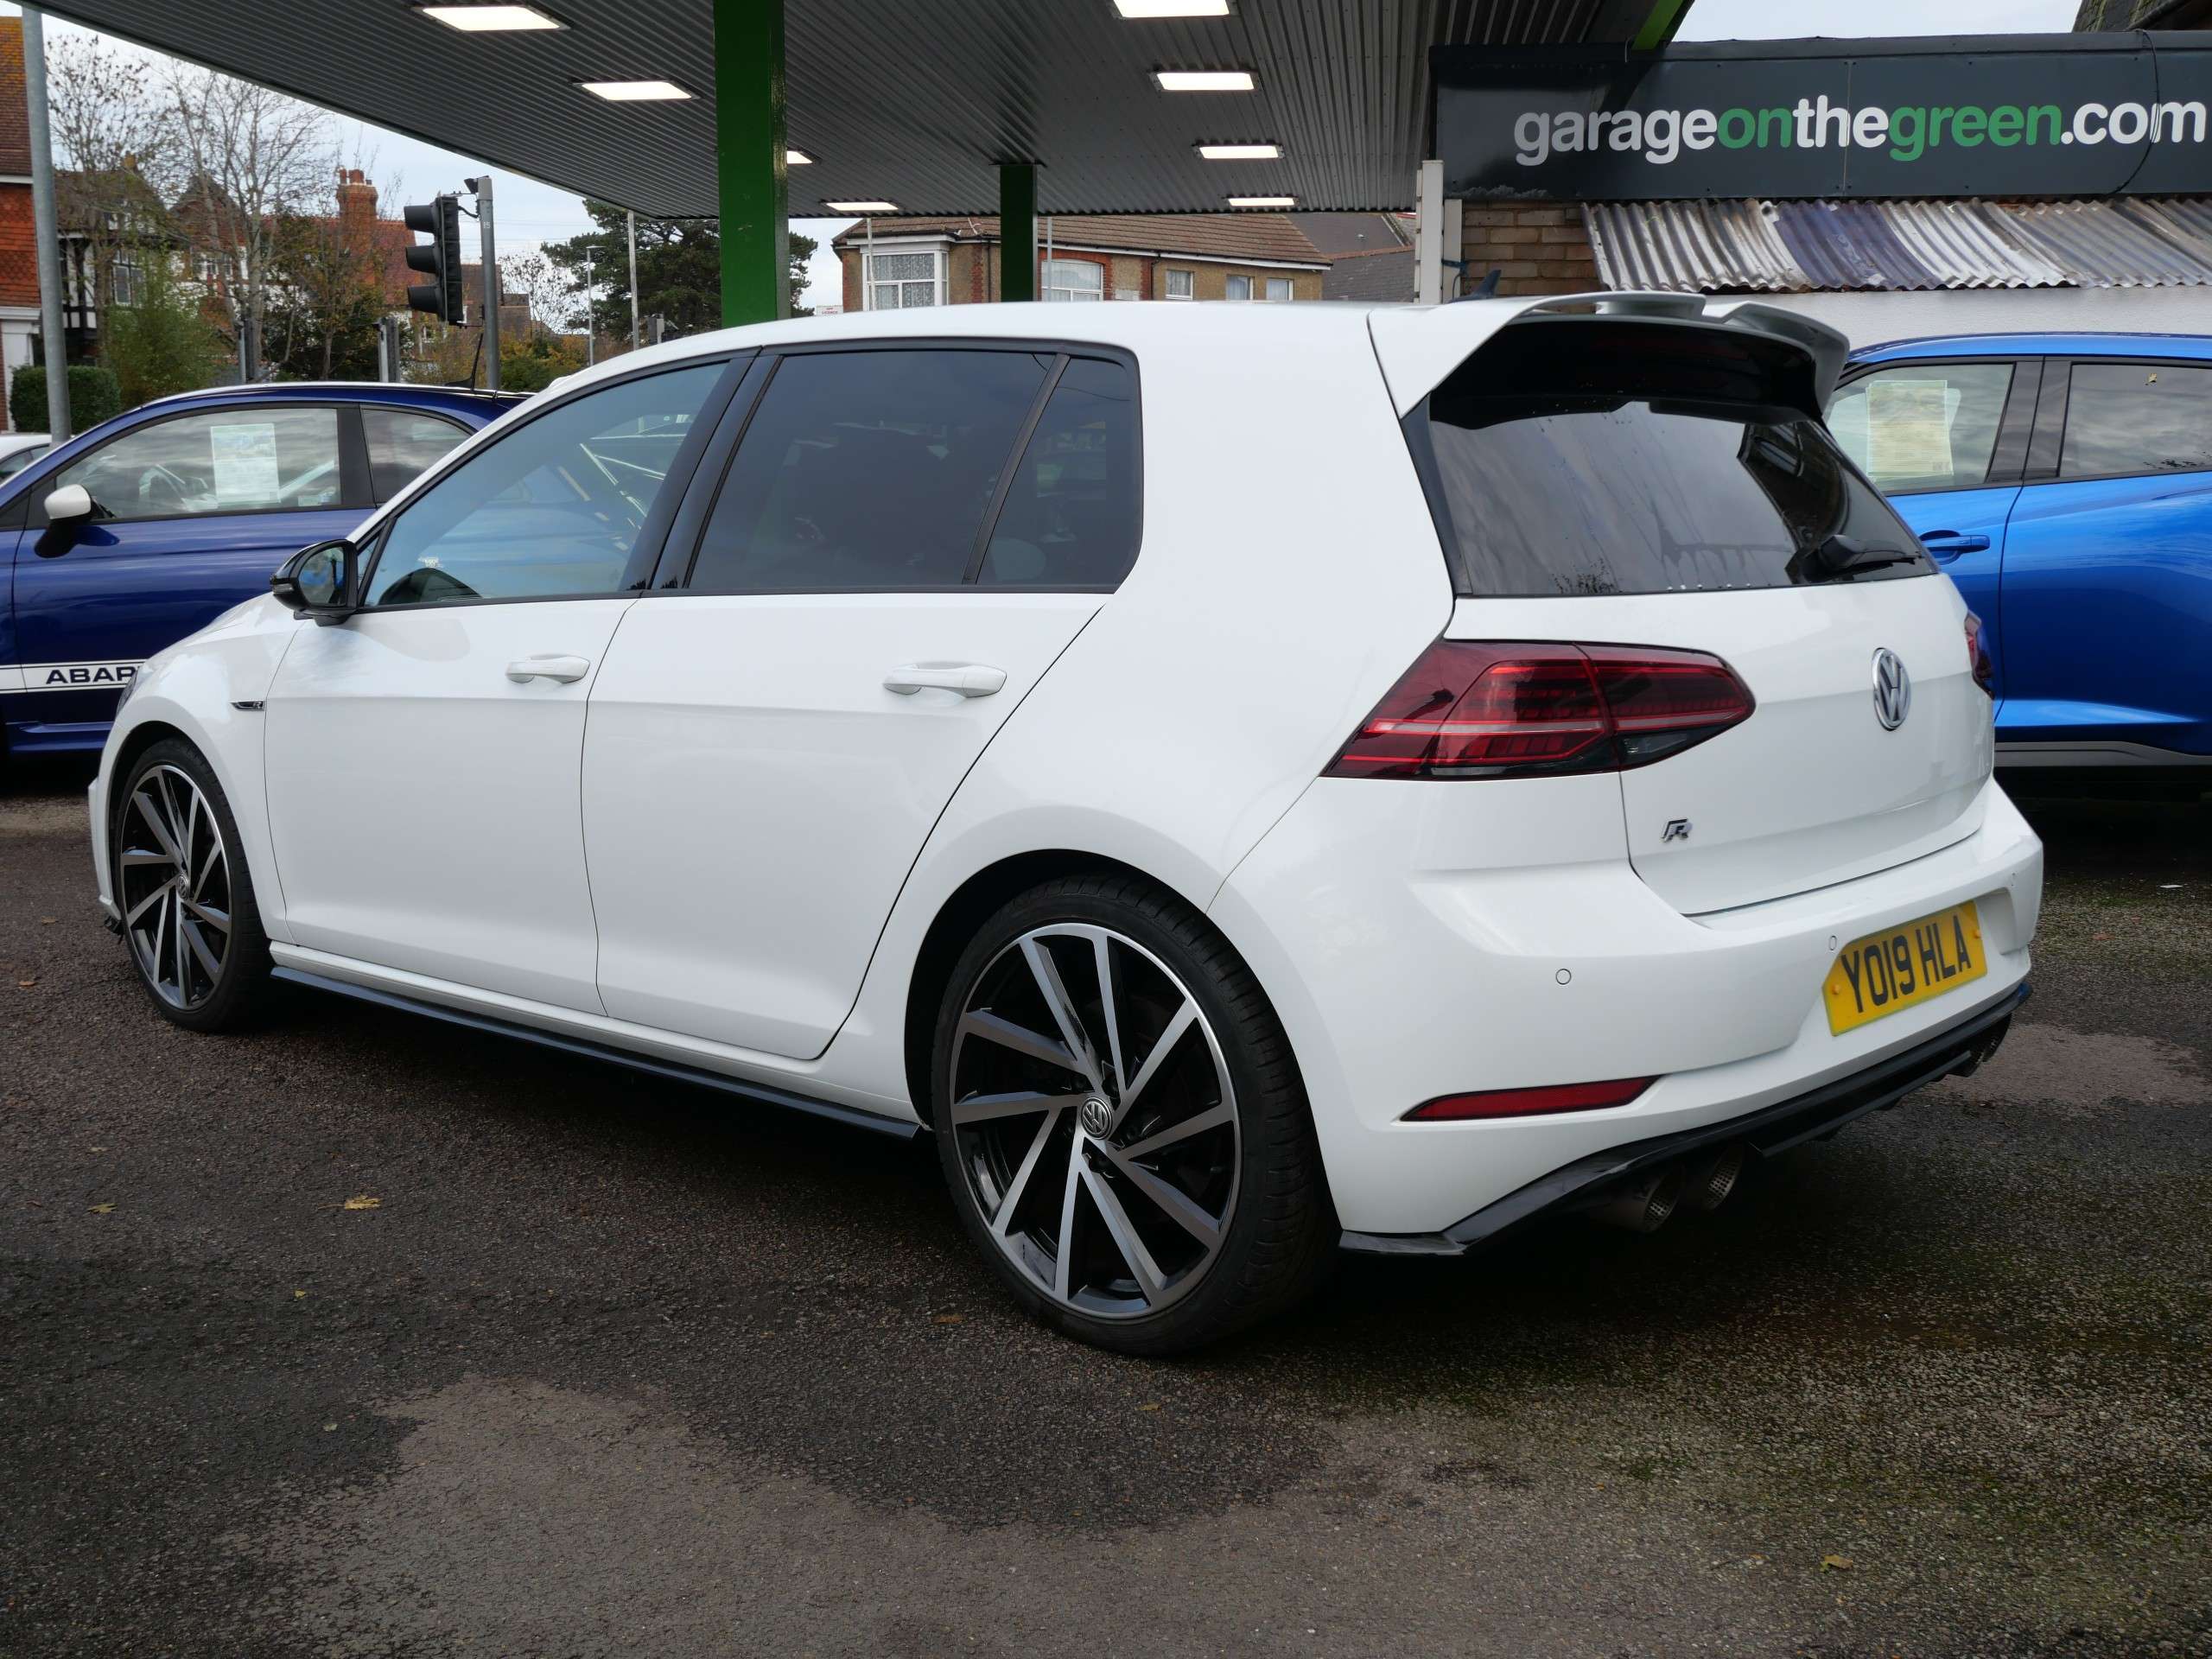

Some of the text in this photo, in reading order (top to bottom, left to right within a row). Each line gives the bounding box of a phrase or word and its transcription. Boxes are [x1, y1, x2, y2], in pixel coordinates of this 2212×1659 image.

[1514, 95, 2207, 166] garageonthegreen.com
[46, 666, 138, 684] ABAR
[1660, 818, 1693, 842] R
[1840, 915, 1972, 1013] YO19 HLA
